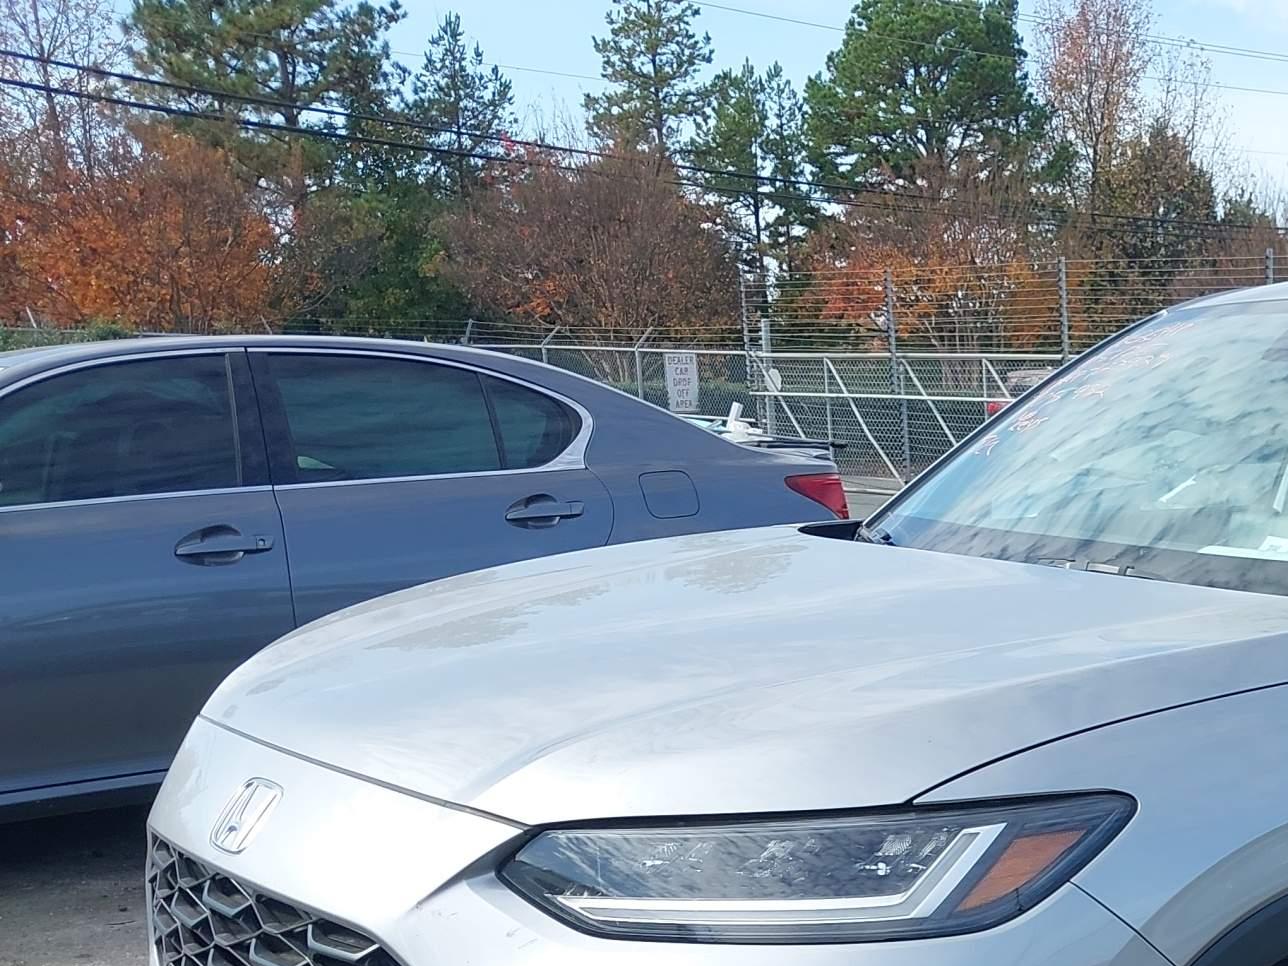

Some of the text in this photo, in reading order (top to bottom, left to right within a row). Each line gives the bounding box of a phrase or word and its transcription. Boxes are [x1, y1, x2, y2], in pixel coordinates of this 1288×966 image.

[667, 355, 694, 365] DEALER
[674, 366, 689, 376] CAR
[672, 377, 690, 387] DROP
[676, 388, 689, 399] OFF
[675, 399, 693, 409] AREA
